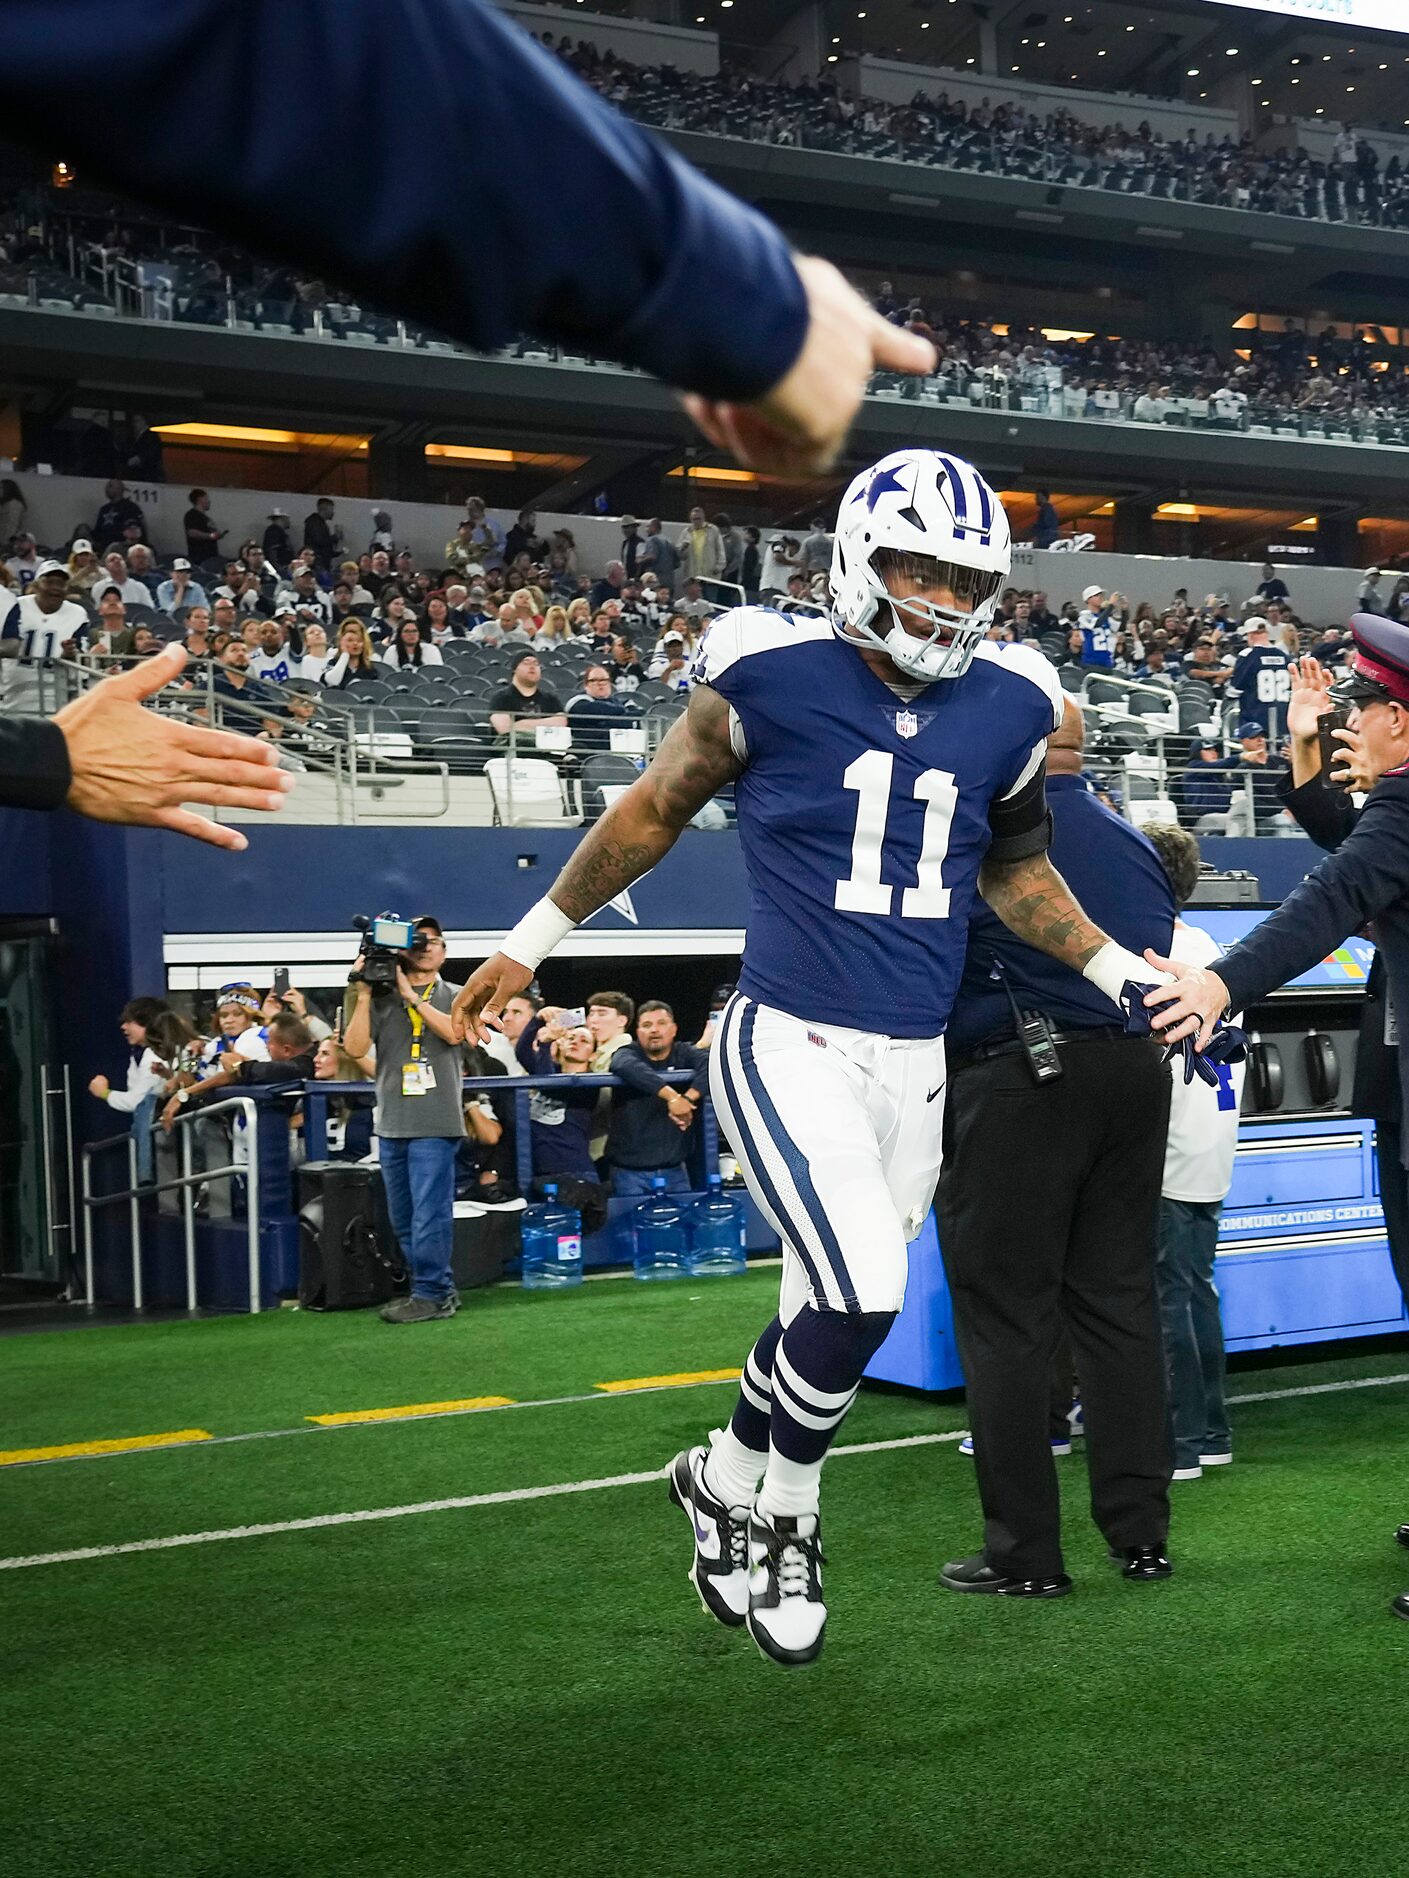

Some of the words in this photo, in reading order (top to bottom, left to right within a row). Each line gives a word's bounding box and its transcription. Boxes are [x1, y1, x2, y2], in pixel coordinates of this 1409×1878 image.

[18, 629, 56, 669] 11
[1256, 668, 1291, 703] 82
[834, 748, 959, 919] 11
[1218, 1210, 1334, 1231] OMMUNICATIONS
